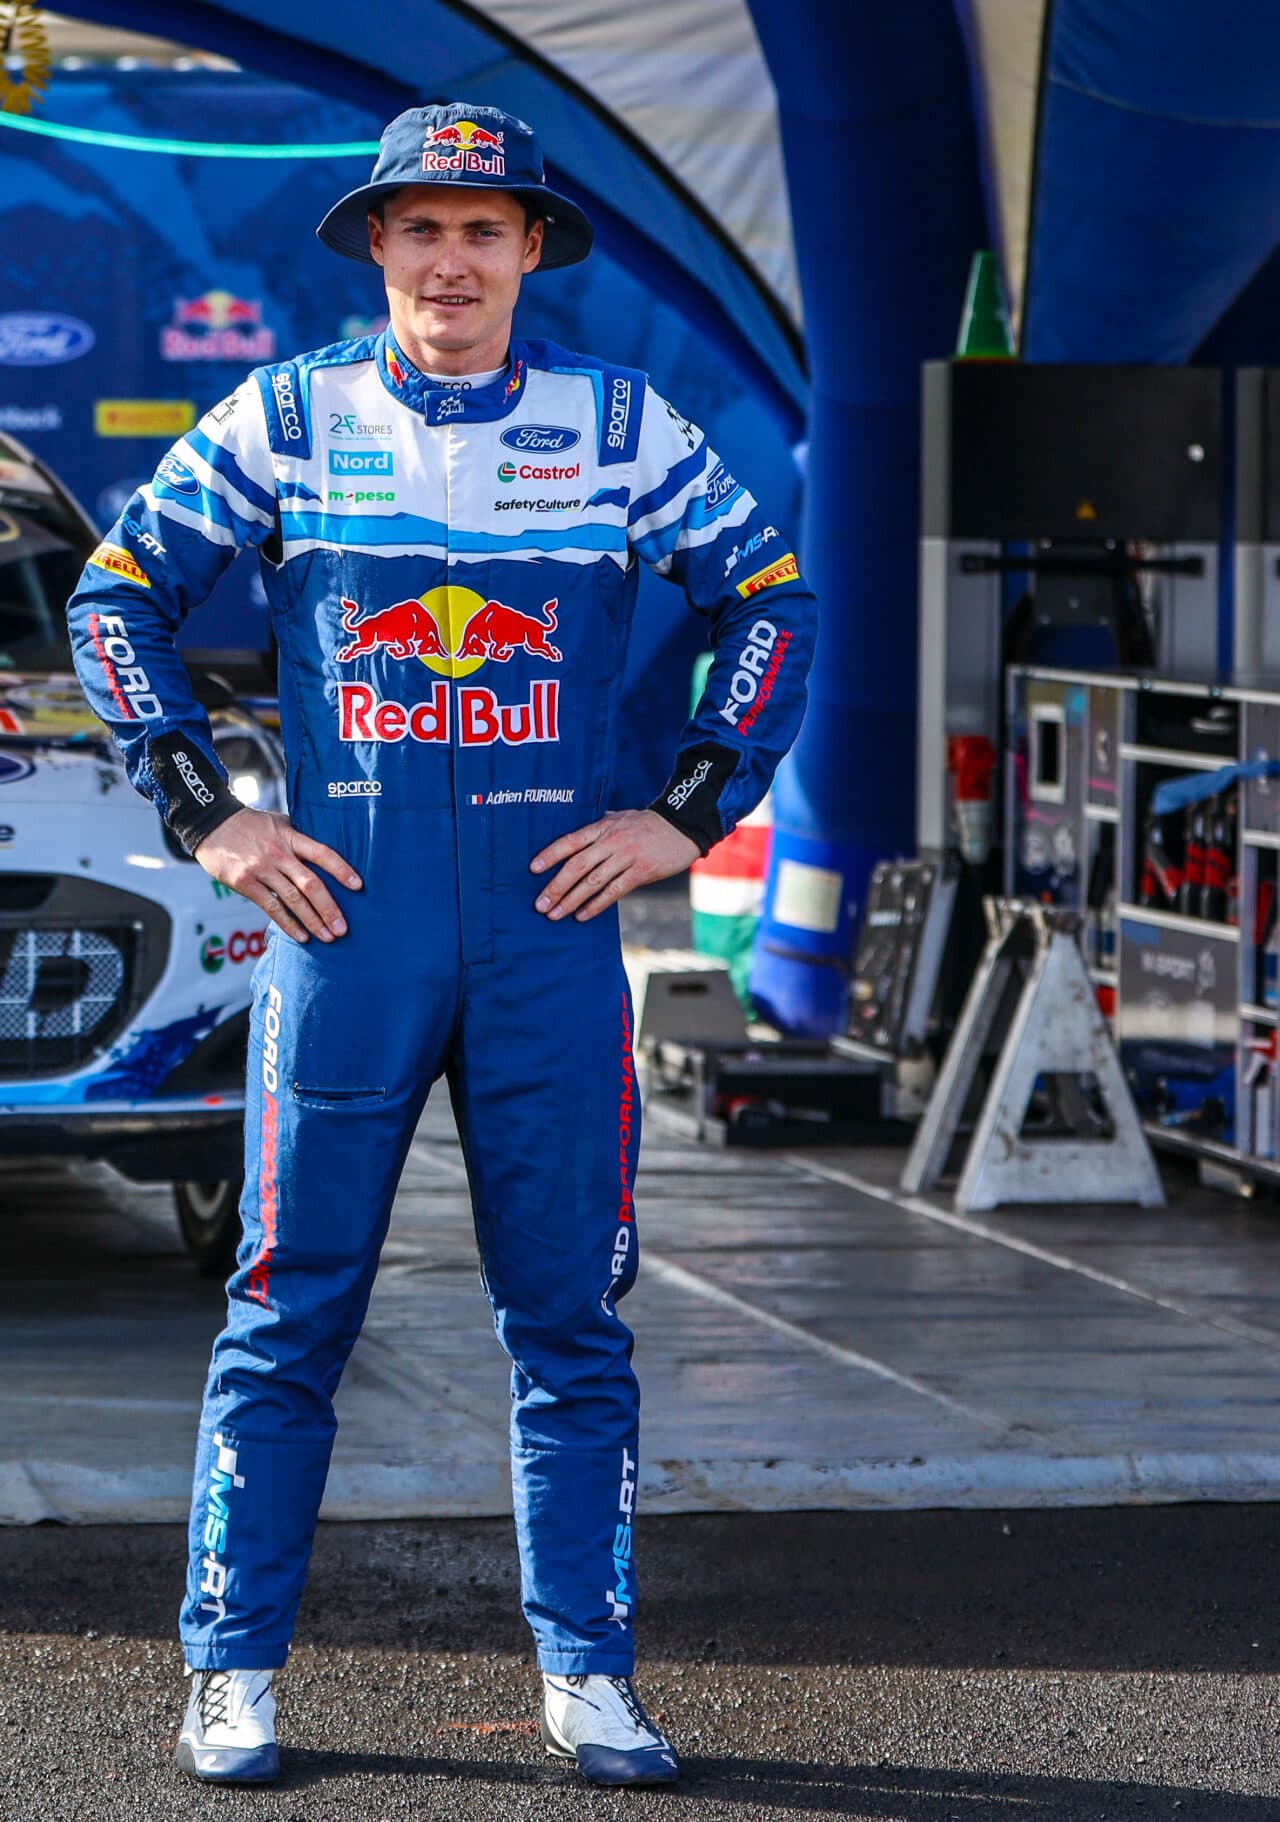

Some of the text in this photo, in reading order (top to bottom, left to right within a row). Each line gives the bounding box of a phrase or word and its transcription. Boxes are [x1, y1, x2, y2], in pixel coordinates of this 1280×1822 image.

[422, 150, 505, 176] Red Bull
[272, 372, 302, 442] sparco
[356, 425, 393, 435] STORES
[606, 378, 631, 451] sparco
[332, 453, 389, 470] Nord
[515, 428, 564, 450] Ford
[519, 463, 580, 481] Castrol
[494, 498, 581, 513] SafetyCulture
[98, 614, 164, 718] FORD
[719, 619, 778, 727] FORD
[736, 628, 794, 737] PERFORMANCE
[337, 679, 560, 747] Red Bull
[327, 780, 382, 798] sparco
[485, 789, 575, 805] Adrien FOURMAUX
[263, 984, 282, 1093] FORD
[613, 1448, 635, 1604] MS-RT
